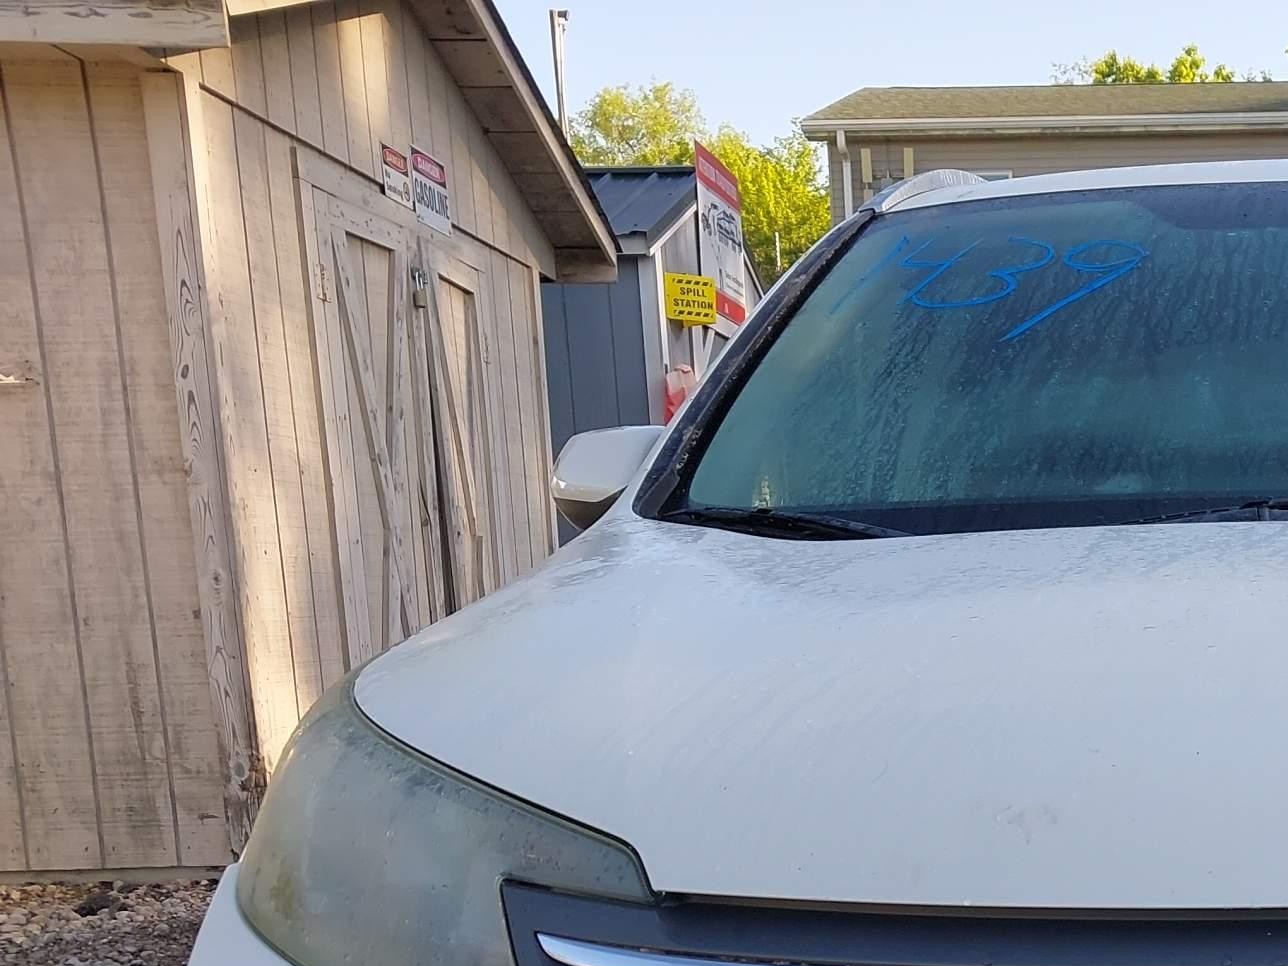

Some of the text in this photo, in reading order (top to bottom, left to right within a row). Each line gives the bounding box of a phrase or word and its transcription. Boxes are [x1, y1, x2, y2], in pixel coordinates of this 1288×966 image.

[415, 177, 450, 220] GASOLINE
[679, 286, 708, 298] SPILL
[672, 298, 714, 311] STATION
